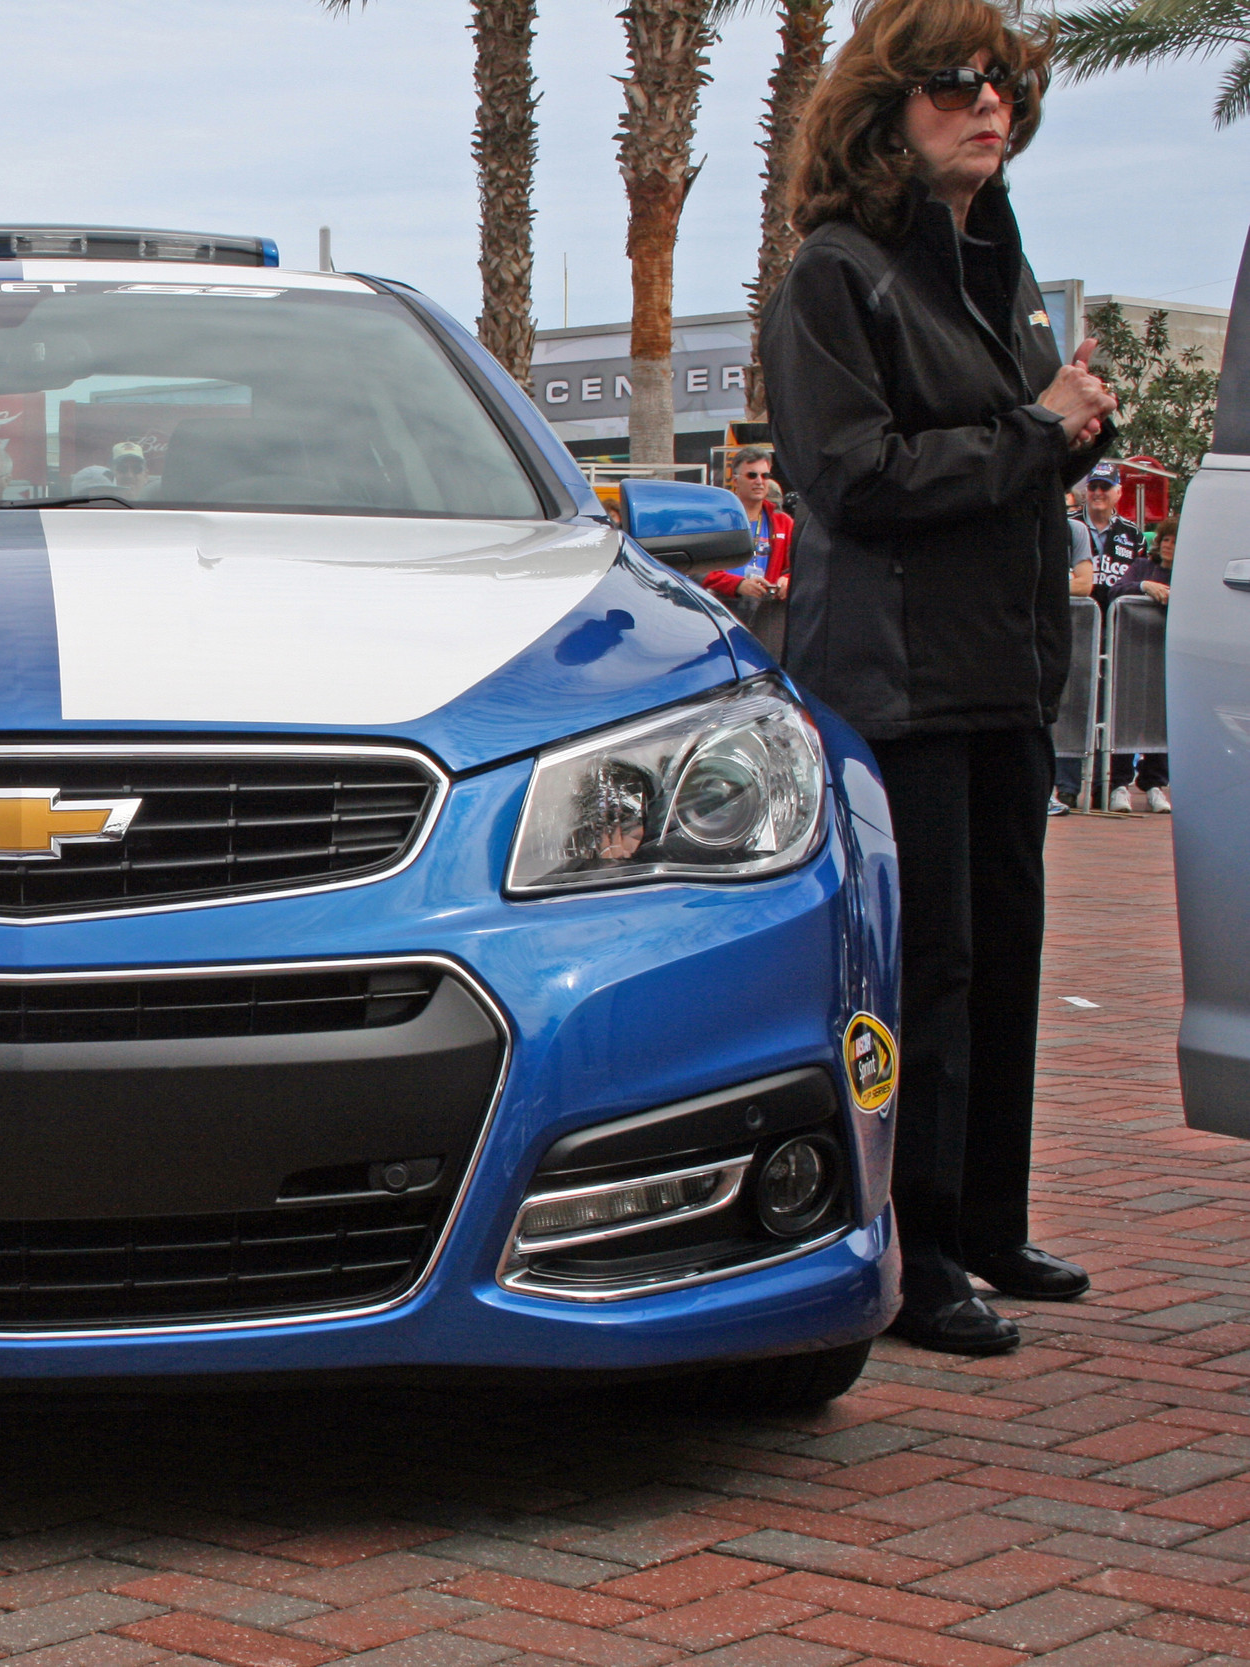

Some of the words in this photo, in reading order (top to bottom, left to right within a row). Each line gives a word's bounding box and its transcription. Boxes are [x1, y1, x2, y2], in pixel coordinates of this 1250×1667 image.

[103, 283, 288, 299] SS
[546, 365, 746, 404] CENER
[859, 1054, 876, 1084] Sprint
